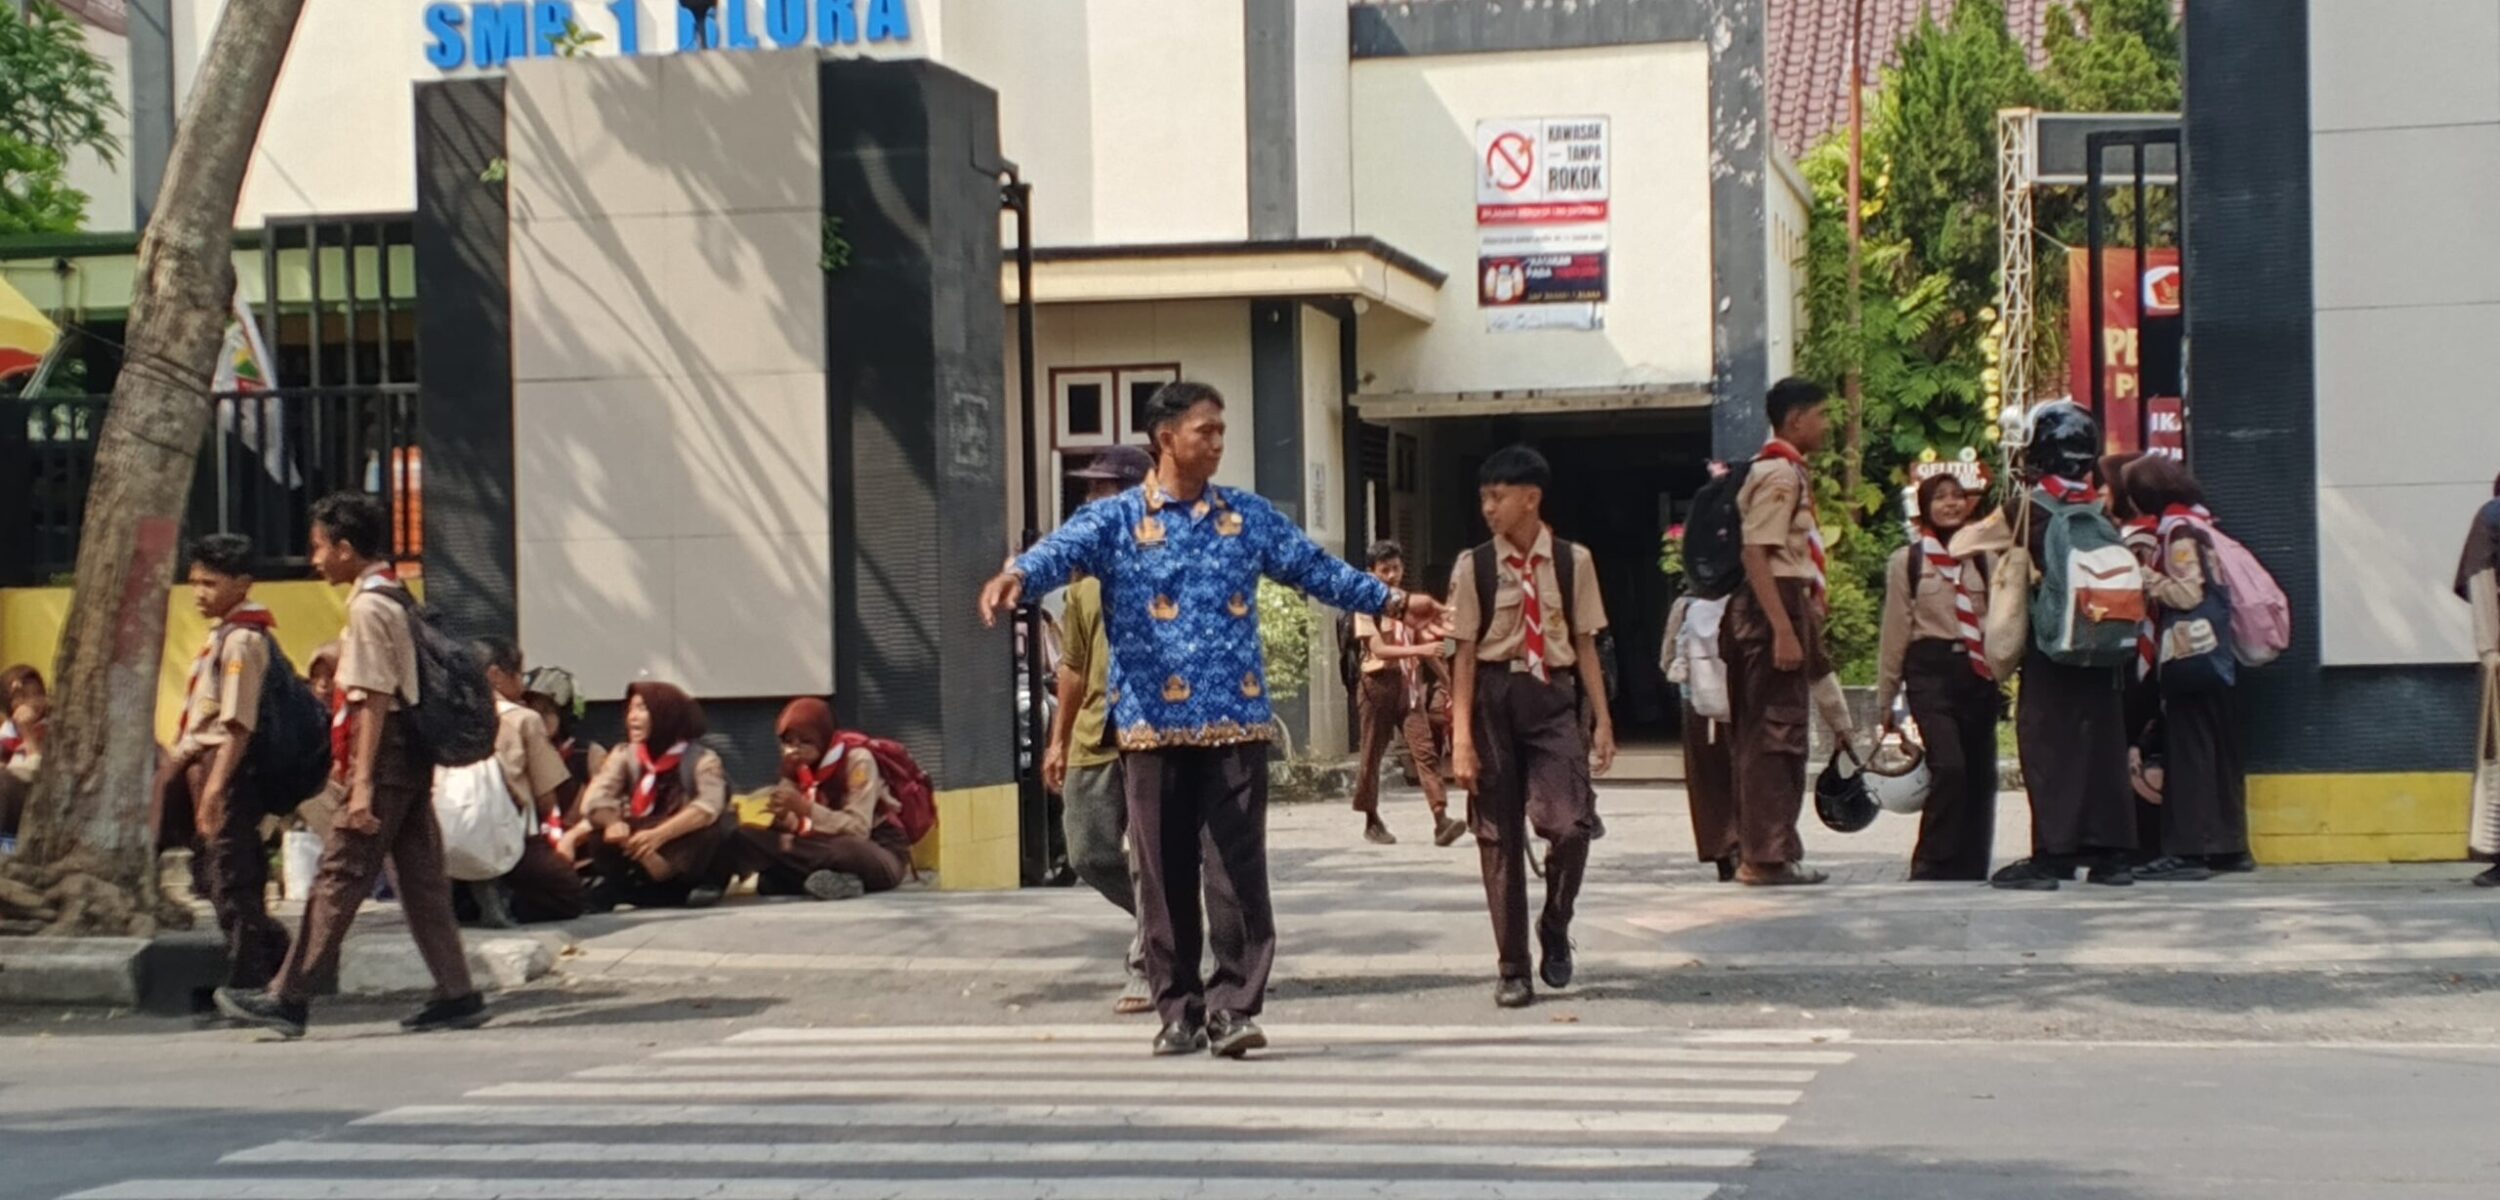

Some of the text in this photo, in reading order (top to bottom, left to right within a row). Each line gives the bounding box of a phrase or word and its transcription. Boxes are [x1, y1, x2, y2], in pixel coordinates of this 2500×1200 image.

[425, 0, 578, 70] SMP
[606, 0, 637, 55] 1
[1548, 124, 1602, 142] KAWASAN
[1567, 144, 1602, 161] TANPA
[1548, 165, 1602, 192] ROKOK
